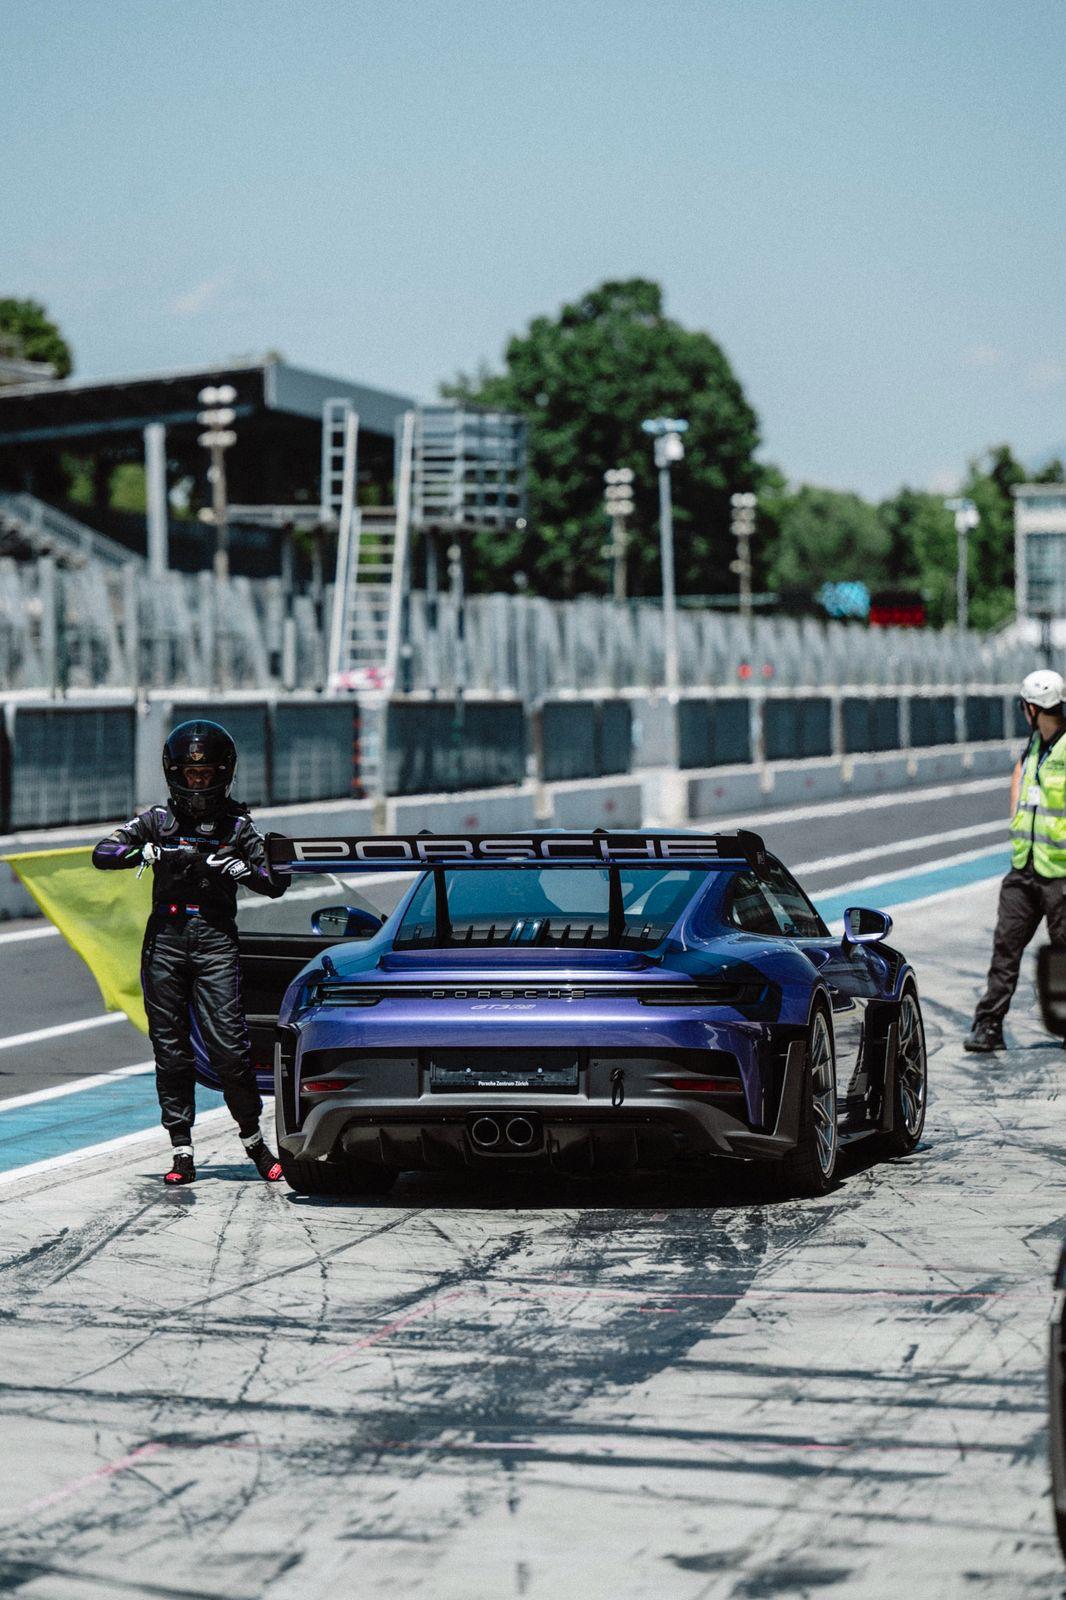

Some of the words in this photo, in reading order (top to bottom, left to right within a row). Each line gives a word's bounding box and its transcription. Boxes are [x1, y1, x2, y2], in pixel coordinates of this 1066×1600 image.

[293, 840, 720, 861] PORSCHE
[229, 861, 246, 875] OMP
[432, 990, 585, 998] PORSCHE
